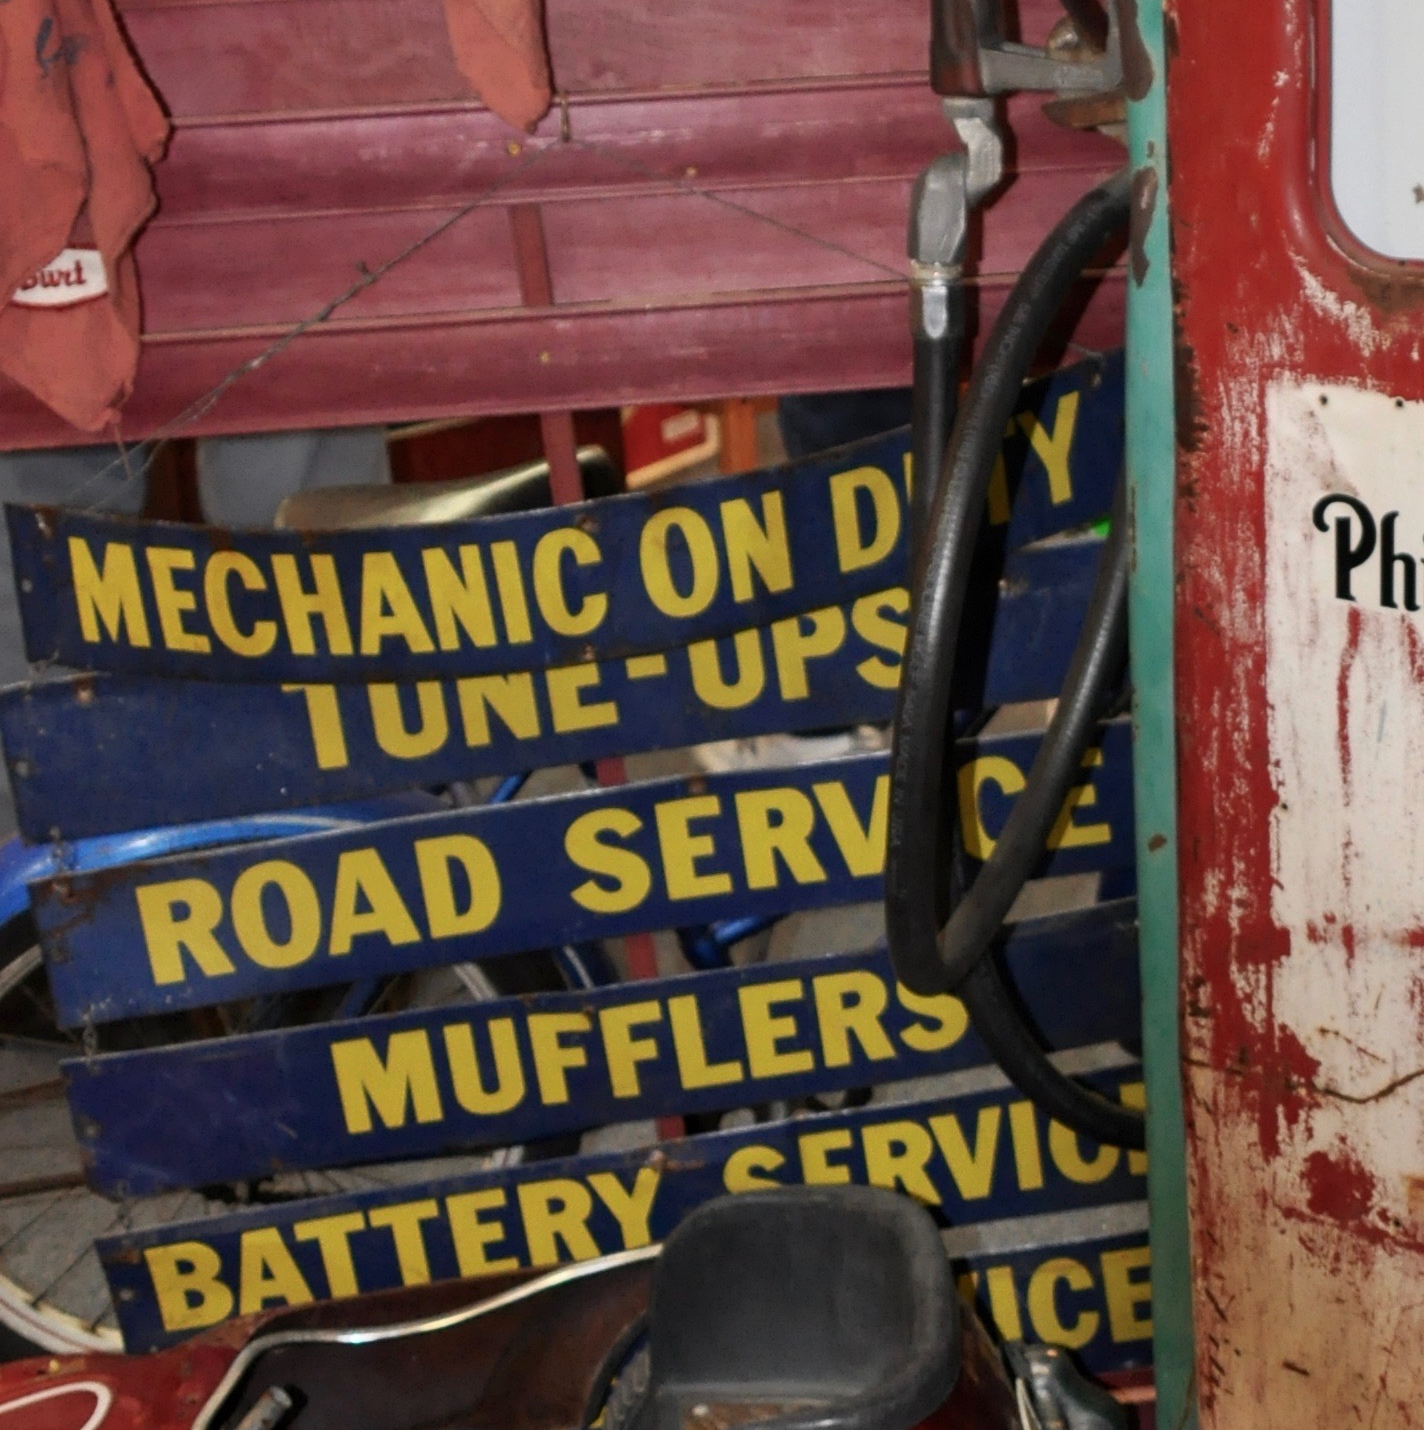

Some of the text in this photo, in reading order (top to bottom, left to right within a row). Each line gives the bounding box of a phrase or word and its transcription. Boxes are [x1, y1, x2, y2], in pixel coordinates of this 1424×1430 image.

[68, 525, 607, 658] MECHANIC
[639, 489, 793, 620] ON
[283, 585, 912, 771] TUNE-UPS
[138, 748, 1113, 989] ROAD SERVCE
[330, 970, 969, 1137] MUFFLERS
[143, 1155, 669, 1335] BATTERY
